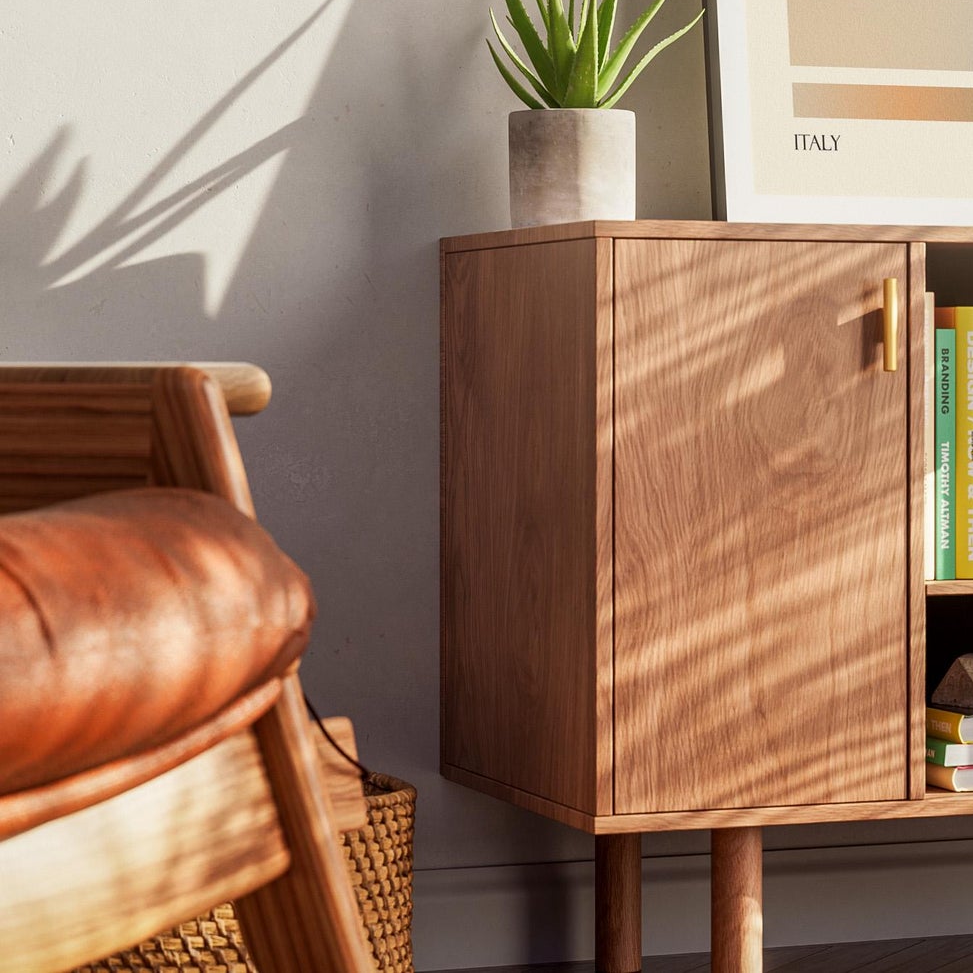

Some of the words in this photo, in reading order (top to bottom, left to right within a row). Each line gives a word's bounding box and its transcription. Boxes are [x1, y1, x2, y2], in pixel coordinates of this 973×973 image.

[793, 133, 841, 152] ITALY
[941, 348, 950, 415] BRANDING
[941, 440, 950, 496] TIMOTHY
[941, 500, 950, 549] ALTMAN
